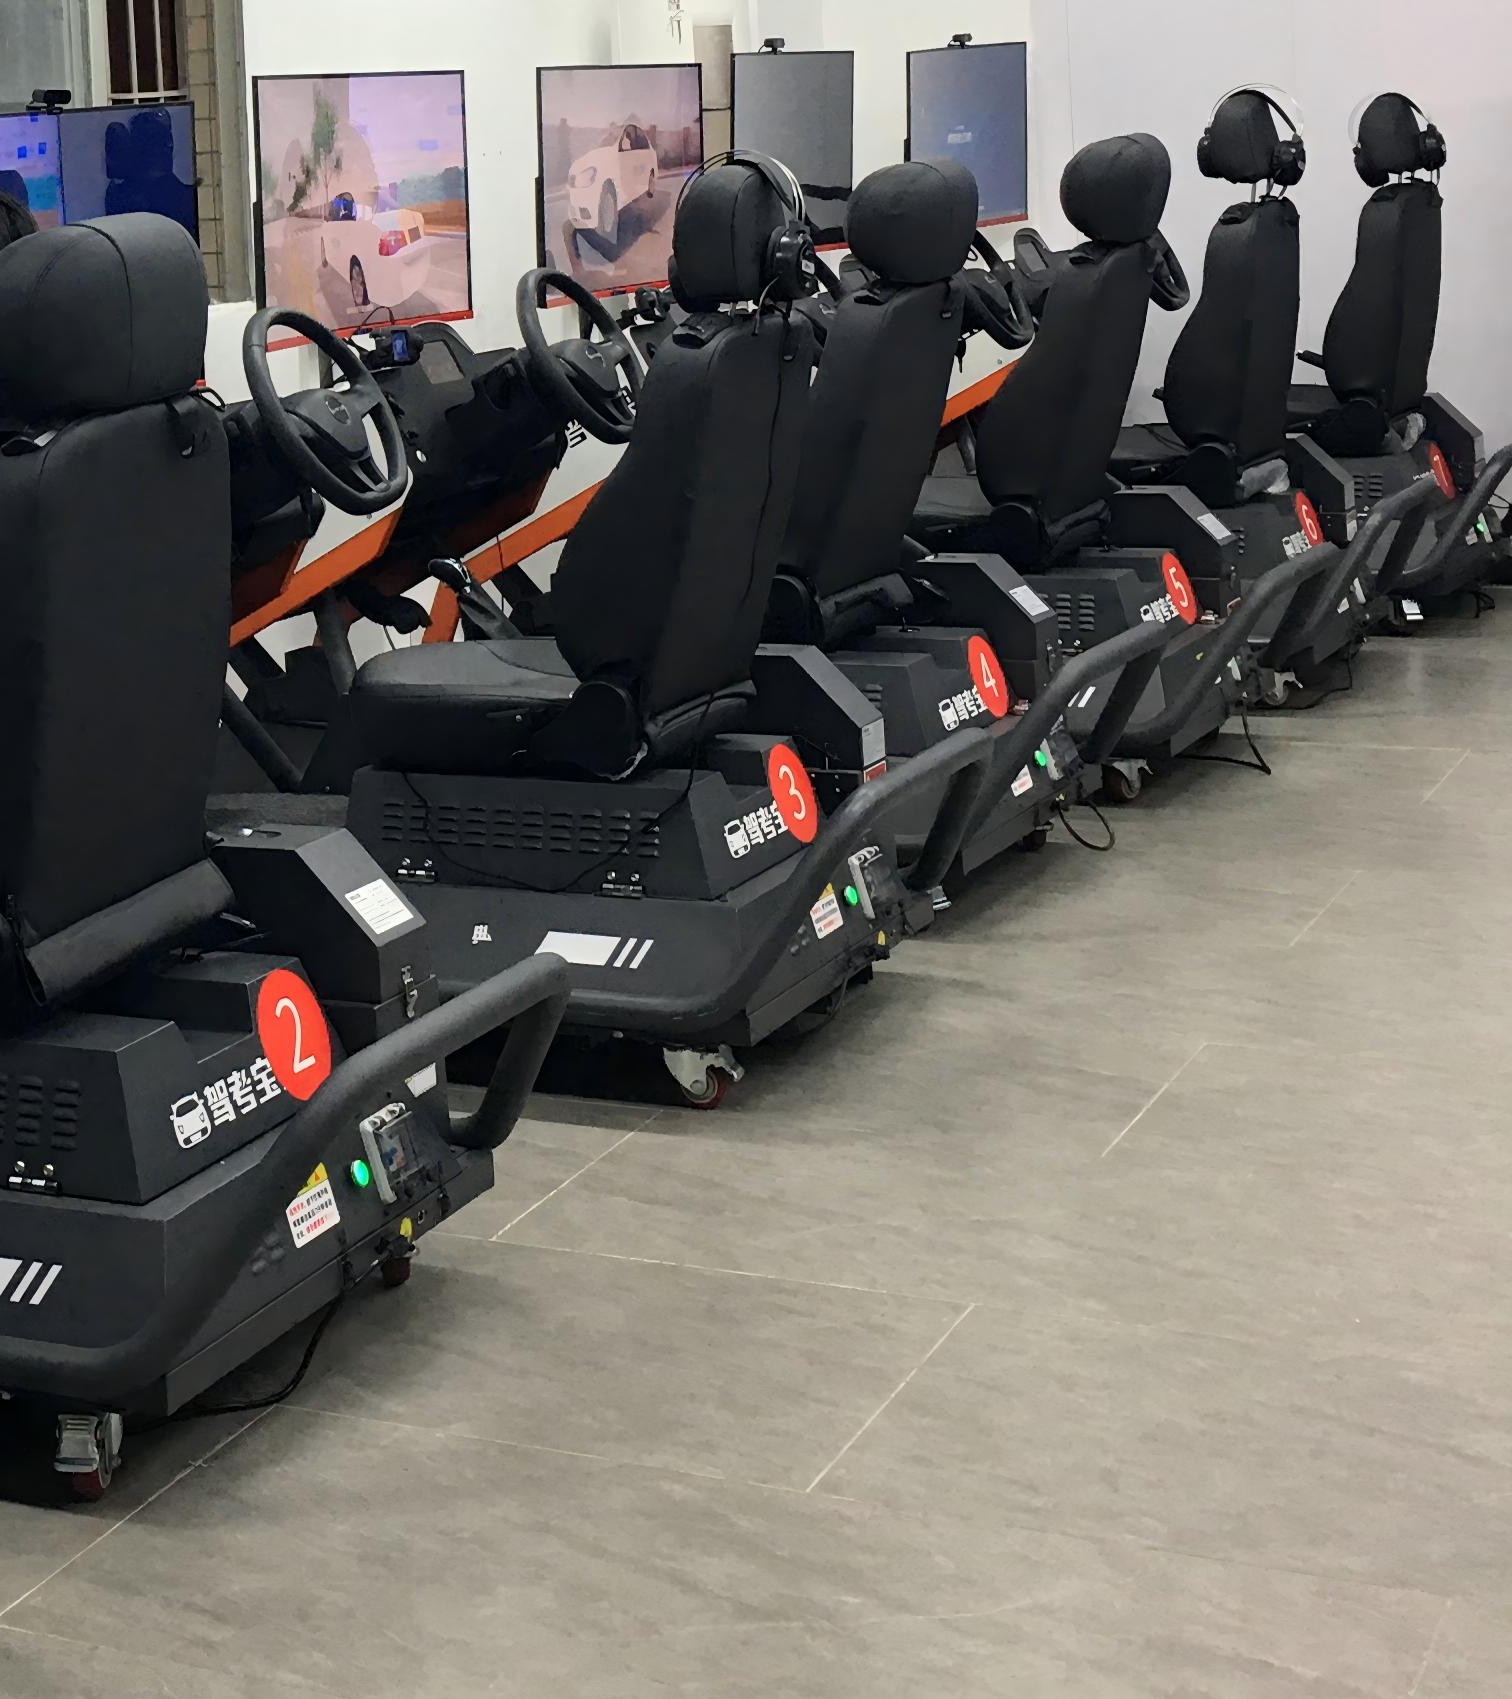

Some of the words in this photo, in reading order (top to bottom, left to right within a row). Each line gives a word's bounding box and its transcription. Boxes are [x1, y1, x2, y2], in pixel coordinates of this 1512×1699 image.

[1302, 504, 1318, 540] 6
[1169, 567, 1188, 608] 5
[980, 652, 999, 697] 4
[779, 765, 806, 820] 3
[275, 998, 316, 1073] 2
[203, 1057, 287, 1126] 驾考宝
